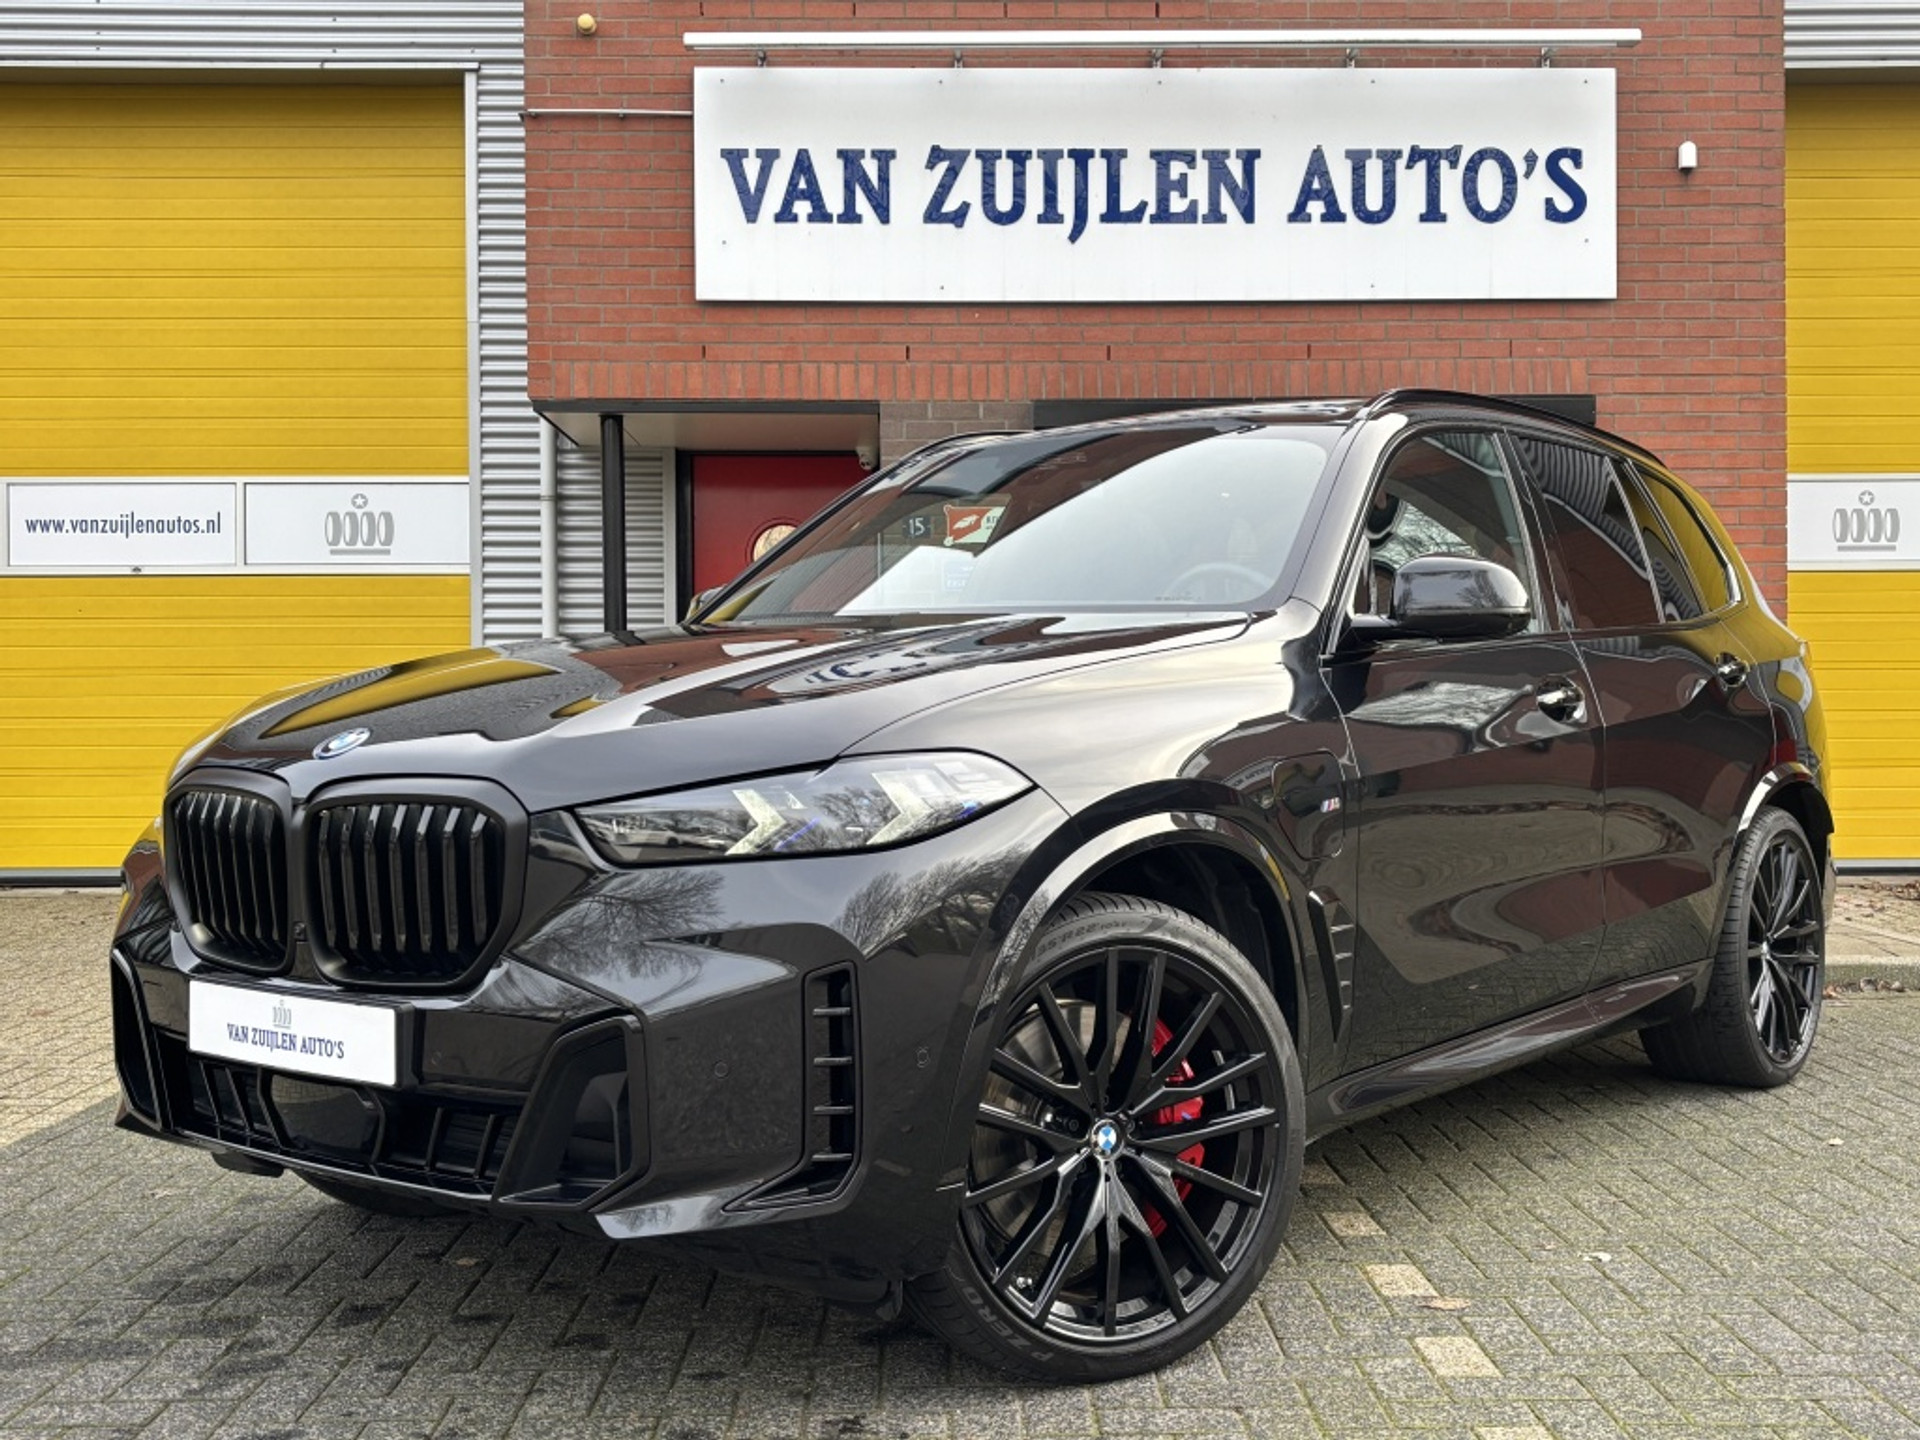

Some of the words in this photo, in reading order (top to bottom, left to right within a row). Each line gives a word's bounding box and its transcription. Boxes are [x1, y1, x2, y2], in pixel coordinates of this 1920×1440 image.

[721, 148, 897, 225] VAN
[922, 144, 1262, 244] ZUIJLEN
[1287, 144, 1589, 225] AUTO'S
[25, 511, 221, 539] www.vanzuijlenautos.nl
[908, 516, 926, 536] 15
[226, 1022, 249, 1044] VAN
[251, 1027, 297, 1053] ZUIJLEN
[300, 1037, 345, 1059] AUTO'S
[961, 1286, 1032, 1350] ZERO
[1030, 1351, 1054, 1362] P
